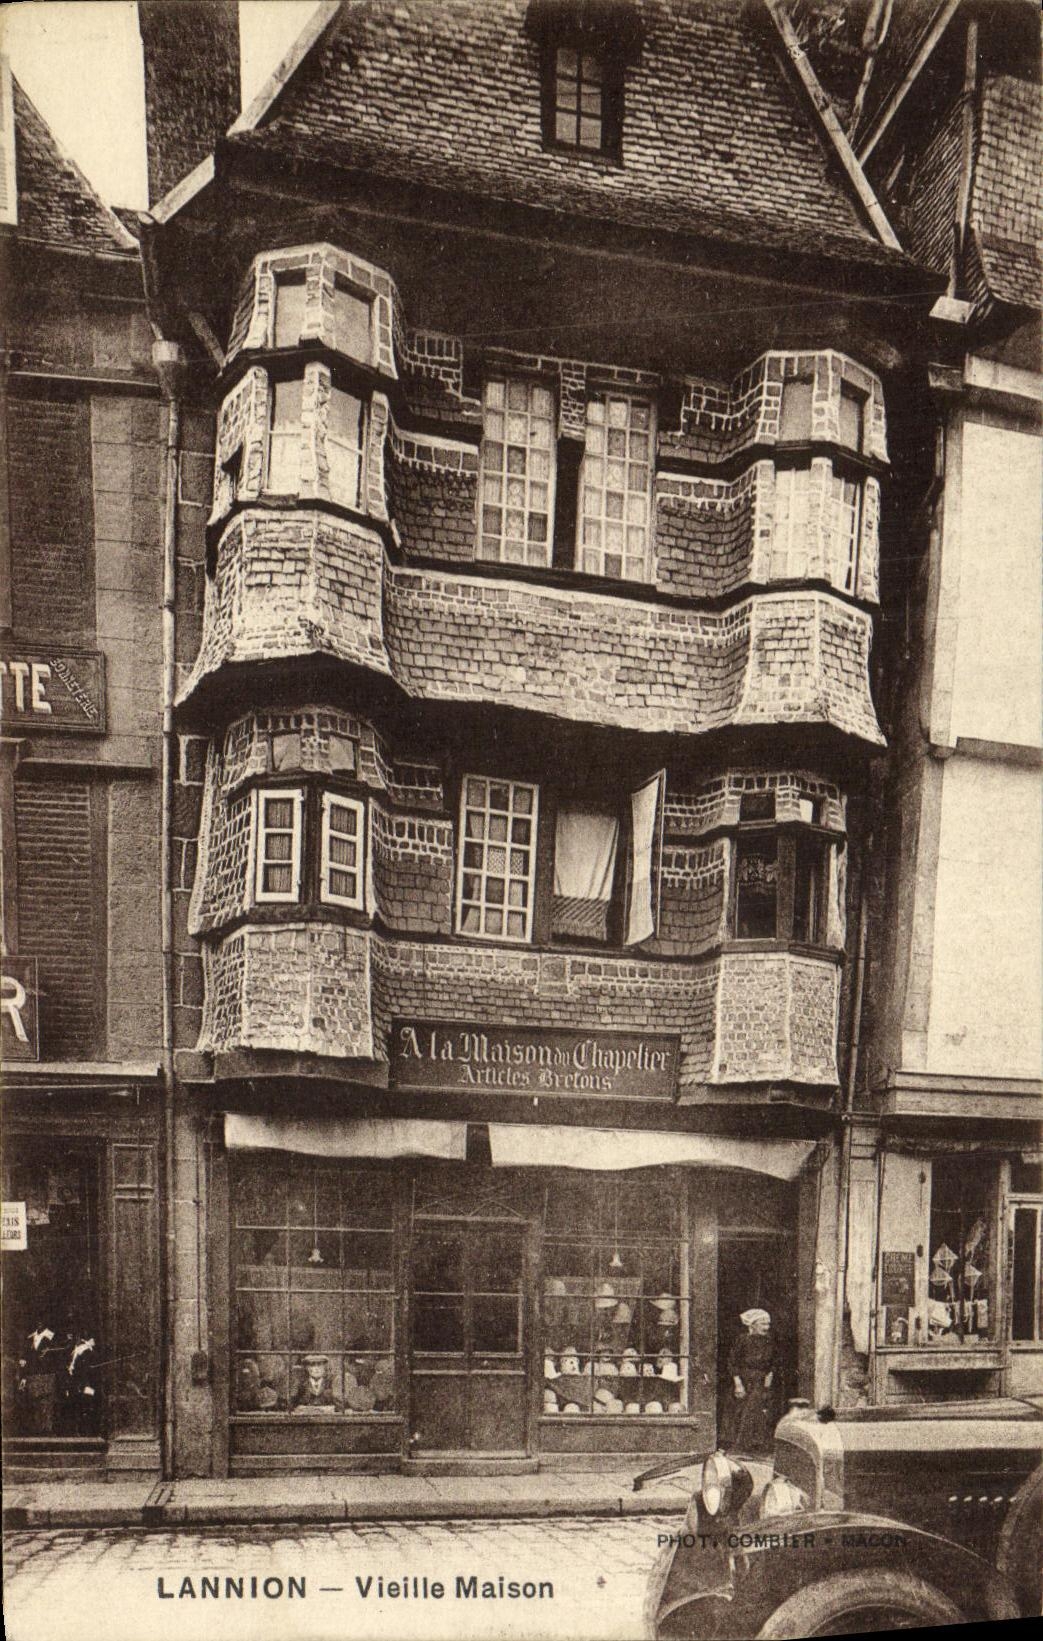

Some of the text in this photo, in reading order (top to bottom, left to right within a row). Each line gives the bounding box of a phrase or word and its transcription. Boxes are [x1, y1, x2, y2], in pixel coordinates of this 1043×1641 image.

[400, 1026, 671, 1076] A la Maison du Chapelier
[457, 1064, 612, 1090] Articles Bretons
